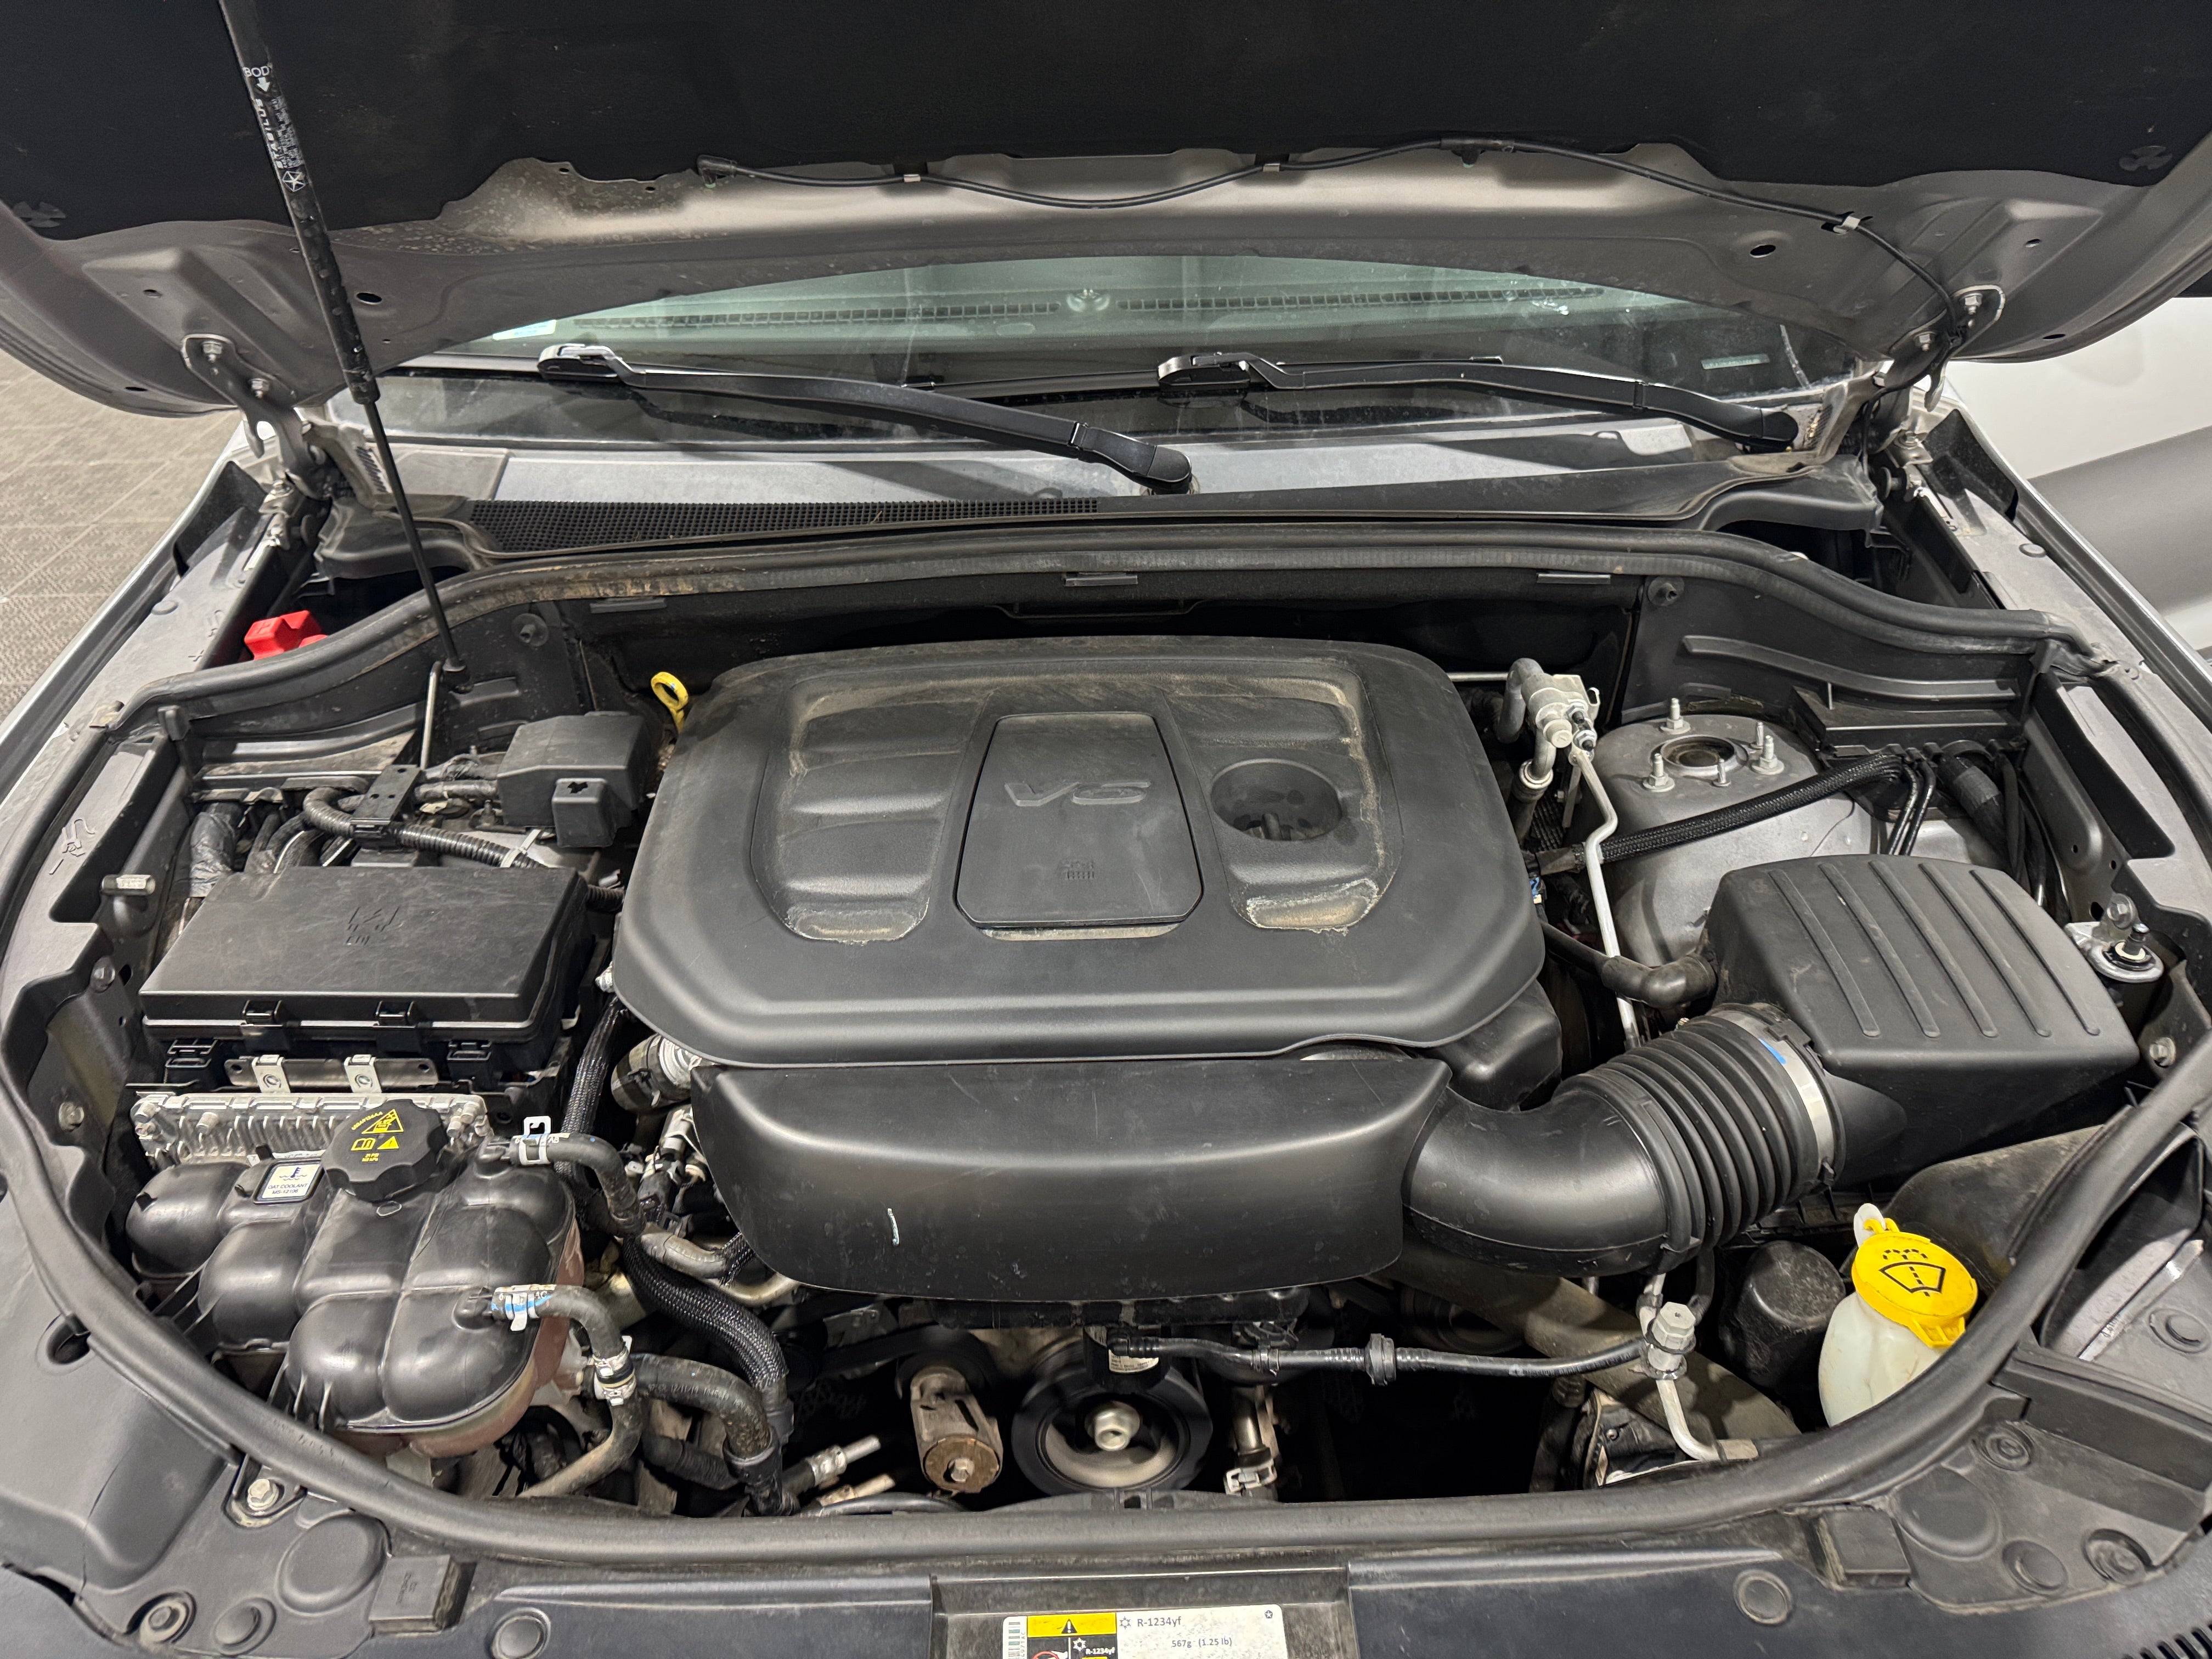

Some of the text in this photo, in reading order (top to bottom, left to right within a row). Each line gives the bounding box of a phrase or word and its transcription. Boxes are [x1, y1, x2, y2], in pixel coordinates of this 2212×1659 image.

[242, 65, 272, 77] BOD
[1004, 781, 1151, 806] V6
[1137, 1616, 1182, 1627] R-1234yf
[1172, 1637, 1232, 1648] 567g (1.25 lb)
